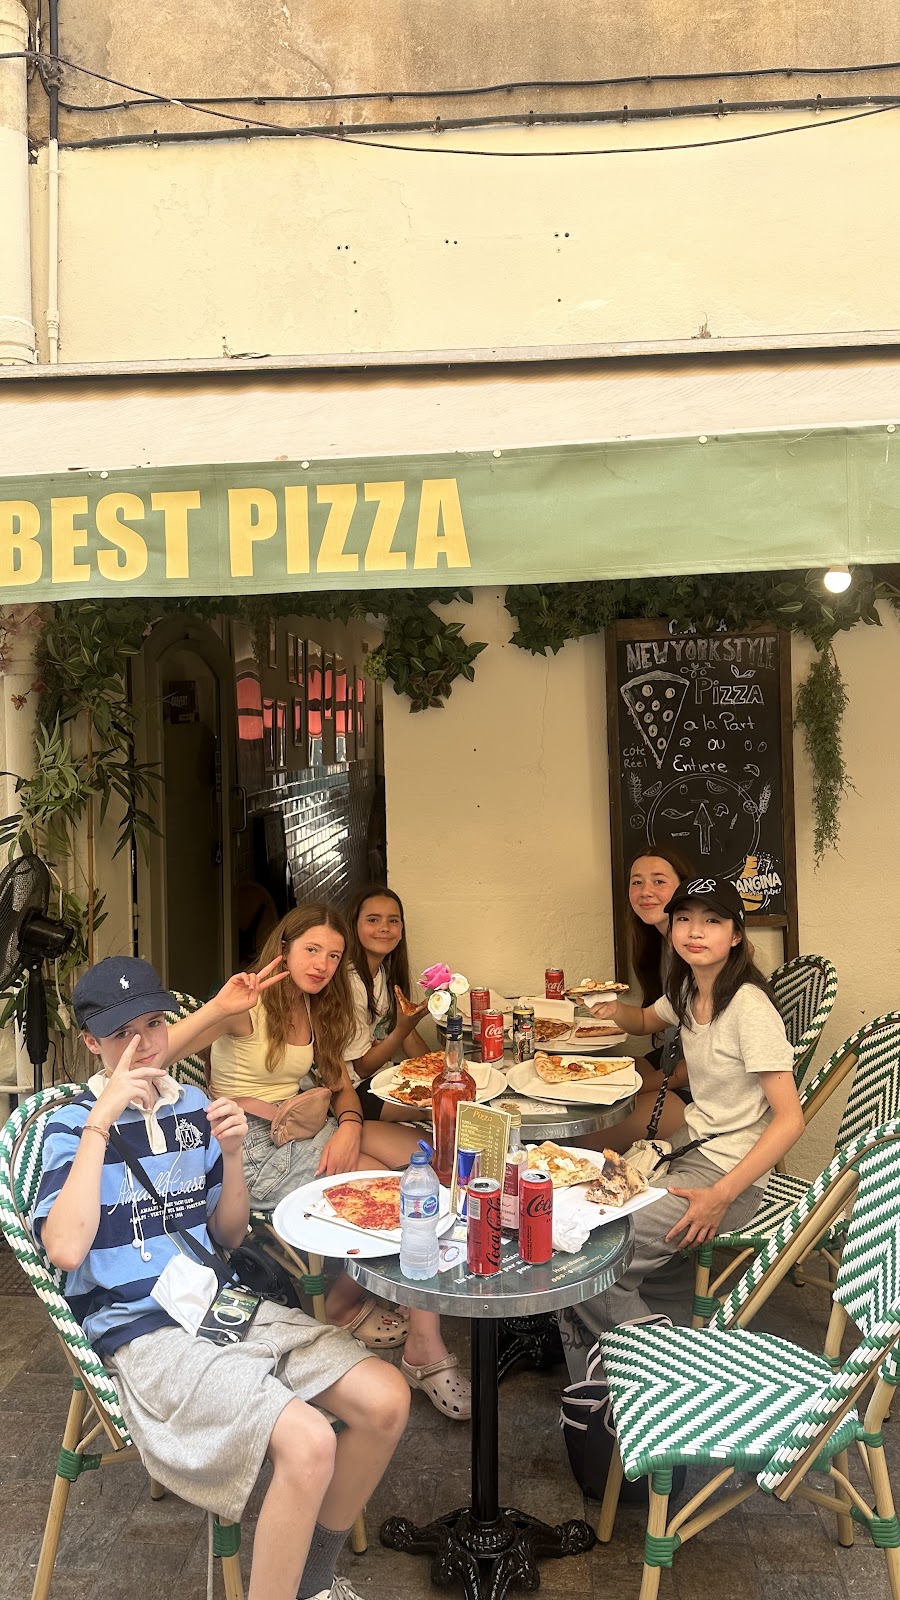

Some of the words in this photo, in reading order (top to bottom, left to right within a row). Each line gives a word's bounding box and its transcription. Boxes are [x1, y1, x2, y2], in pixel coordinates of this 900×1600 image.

[0, 490, 201, 587] BEST
[228, 478, 472, 578] PIZZA
[626, 640, 669, 673] NEW
[670, 638, 722, 662] YORK
[723, 636, 776, 671] STYLE
[702, 714, 718, 731] la
[718, 711, 756, 731] Part
[672, 754, 728, 773] Entiere
[730, 872, 782, 893] ANGINA
[170, 1169, 206, 1197] Coast
